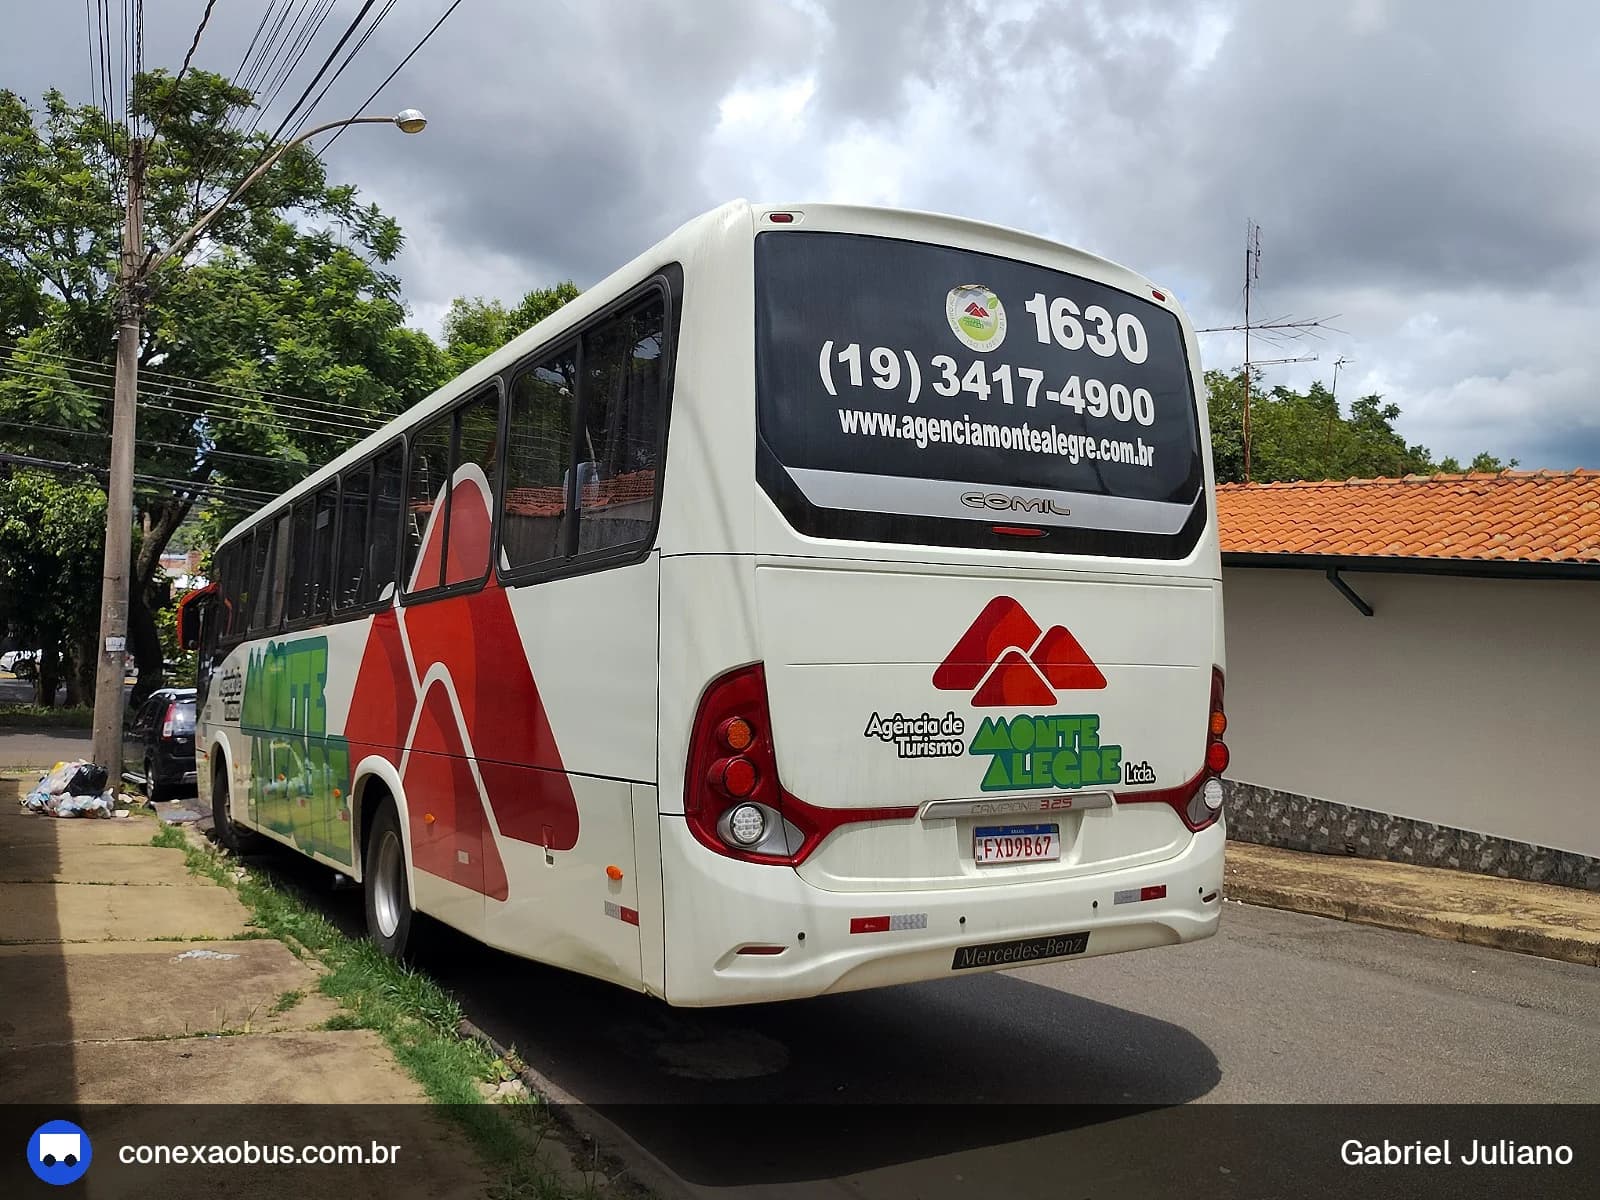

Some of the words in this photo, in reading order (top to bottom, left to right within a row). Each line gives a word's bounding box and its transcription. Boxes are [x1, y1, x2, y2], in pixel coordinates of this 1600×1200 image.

[1025, 293, 1149, 365] 1630
[819, 340, 922, 404] (19)
[930, 355, 1155, 426] 3417-4900
[838, 408, 1154, 467] www.agenciamontealegre.com.br
[960, 491, 1070, 516] COMIL
[864, 712, 940, 742] Agência
[941, 711, 965, 736] de
[969, 714, 1100, 755] MONTE
[894, 736, 965, 758] Turismo
[980, 745, 1122, 792] ALEGRE
[1125, 761, 1156, 785] Ltda.
[971, 801, 1038, 815] CAMPIONE
[1040, 797, 1073, 811] 325
[984, 836, 1052, 859] FXD9B67
[960, 937, 1083, 967] Mercedes-Benz
